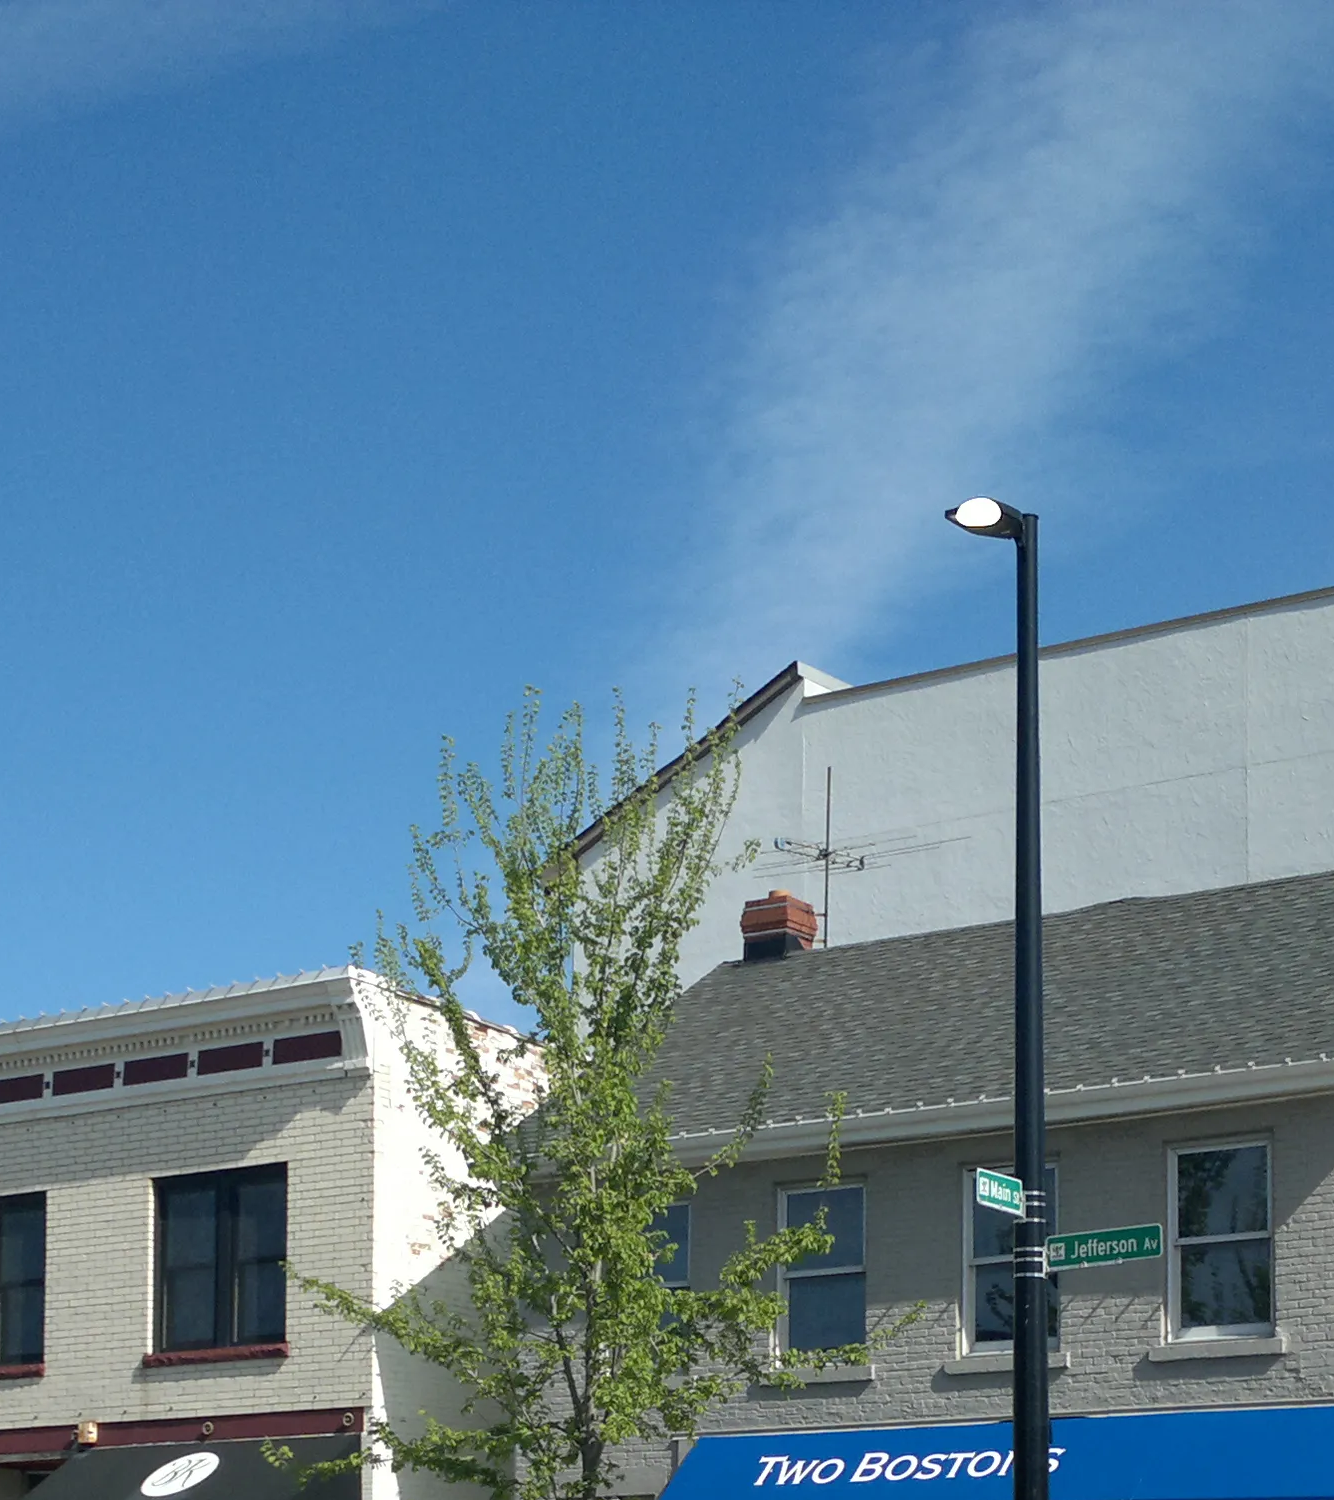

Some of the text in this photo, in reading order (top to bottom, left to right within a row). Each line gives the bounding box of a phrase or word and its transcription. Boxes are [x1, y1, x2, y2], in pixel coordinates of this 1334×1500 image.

[990, 1180, 1011, 1202] Main
[1070, 1236, 1158, 1259] Jefferson Av
[753, 1455, 845, 1487] TWO
